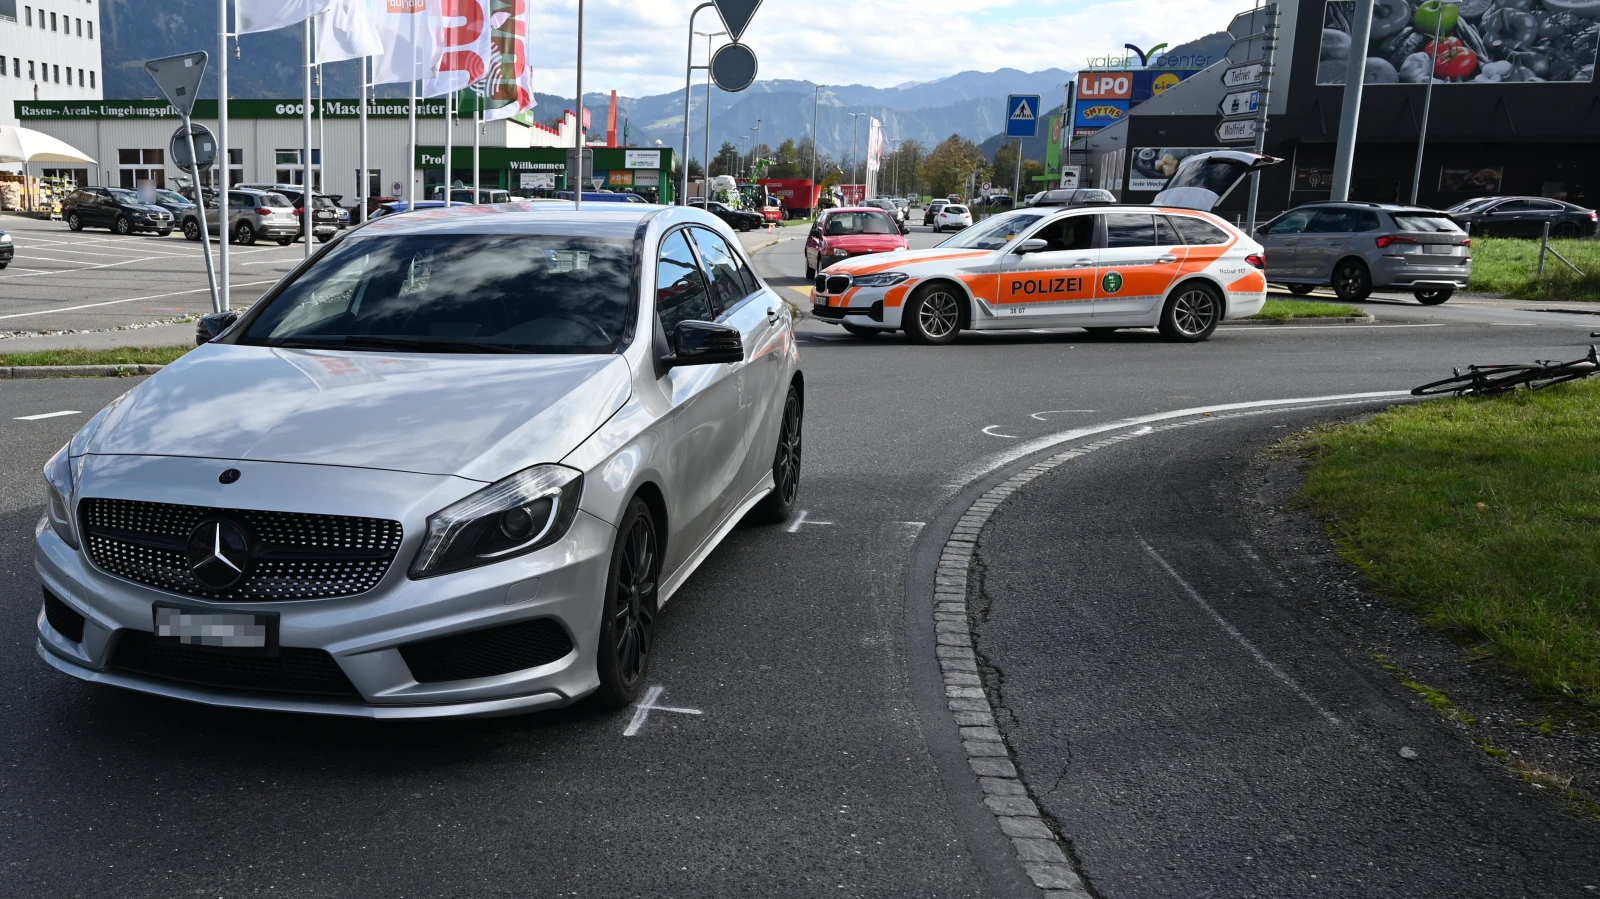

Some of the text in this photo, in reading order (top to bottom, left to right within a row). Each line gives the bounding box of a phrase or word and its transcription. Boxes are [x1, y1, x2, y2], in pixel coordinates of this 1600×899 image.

[1087, 52, 1211, 67] valeis center
[1231, 69, 1251, 82] Tiefriet
[1083, 107, 1121, 118] SMYTHS
[1224, 123, 1246, 136] Wolfriet
[509, 161, 565, 169] Willkommen
[1011, 277, 1083, 295] POLIZEI
